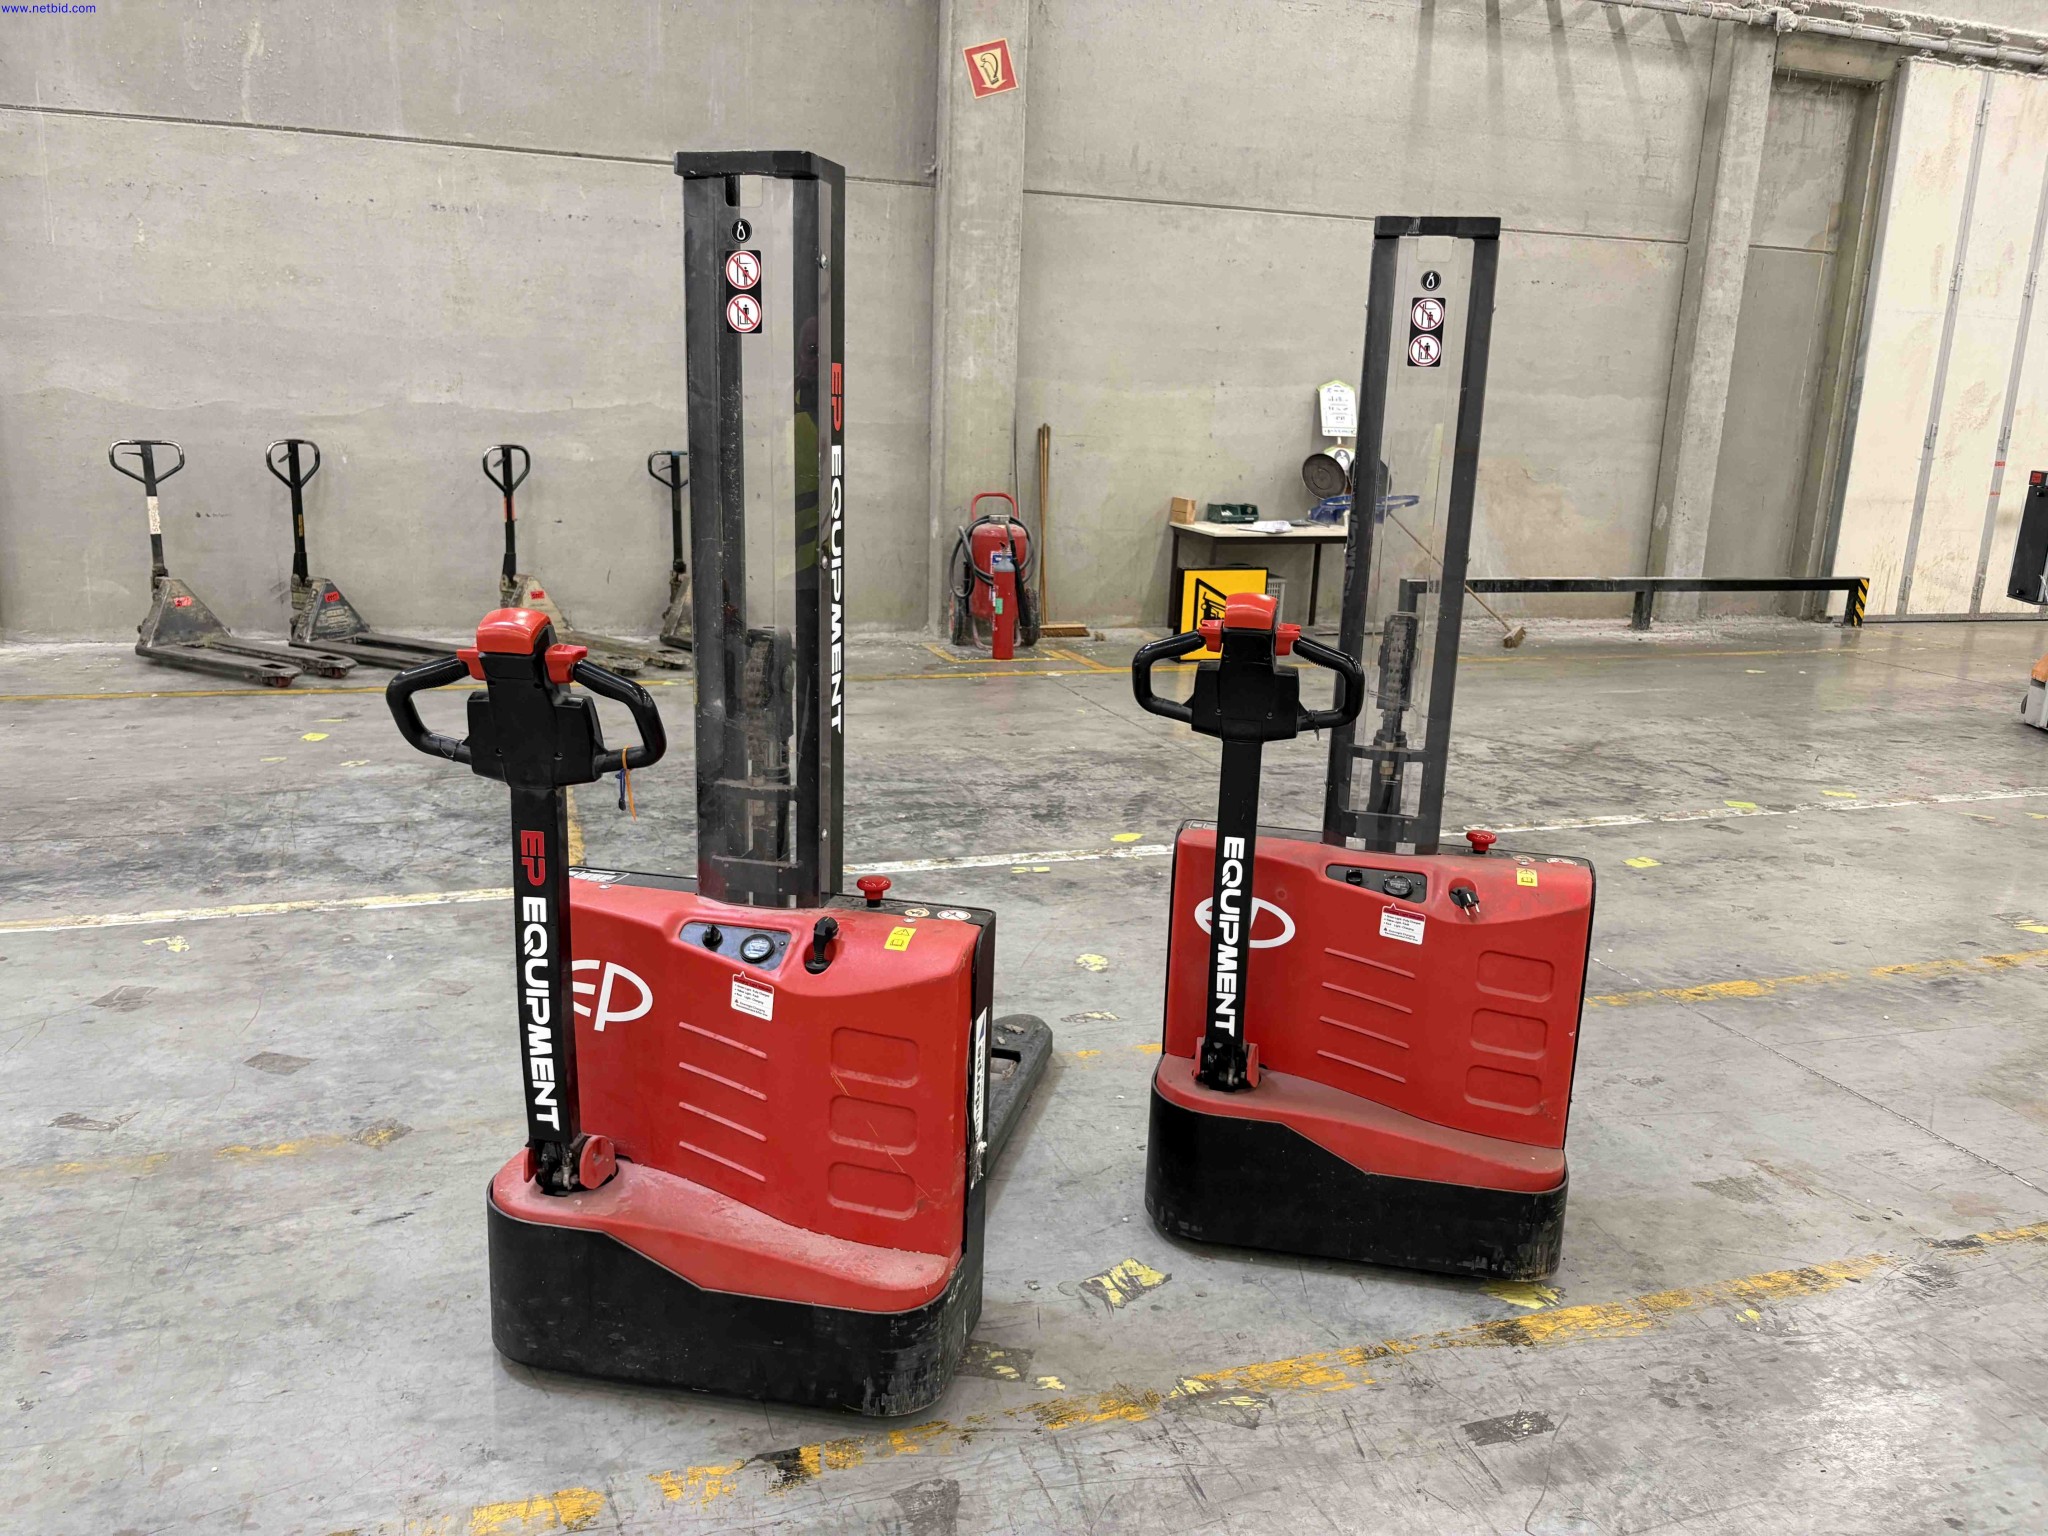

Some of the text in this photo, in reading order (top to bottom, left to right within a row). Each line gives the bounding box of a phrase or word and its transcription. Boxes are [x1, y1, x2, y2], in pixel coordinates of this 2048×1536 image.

[831, 362, 842, 734] EP EQUIPMENT
[520, 829, 560, 1132] EP EQUIPMENT
[1214, 836, 1246, 1038] EQUIPMENT
